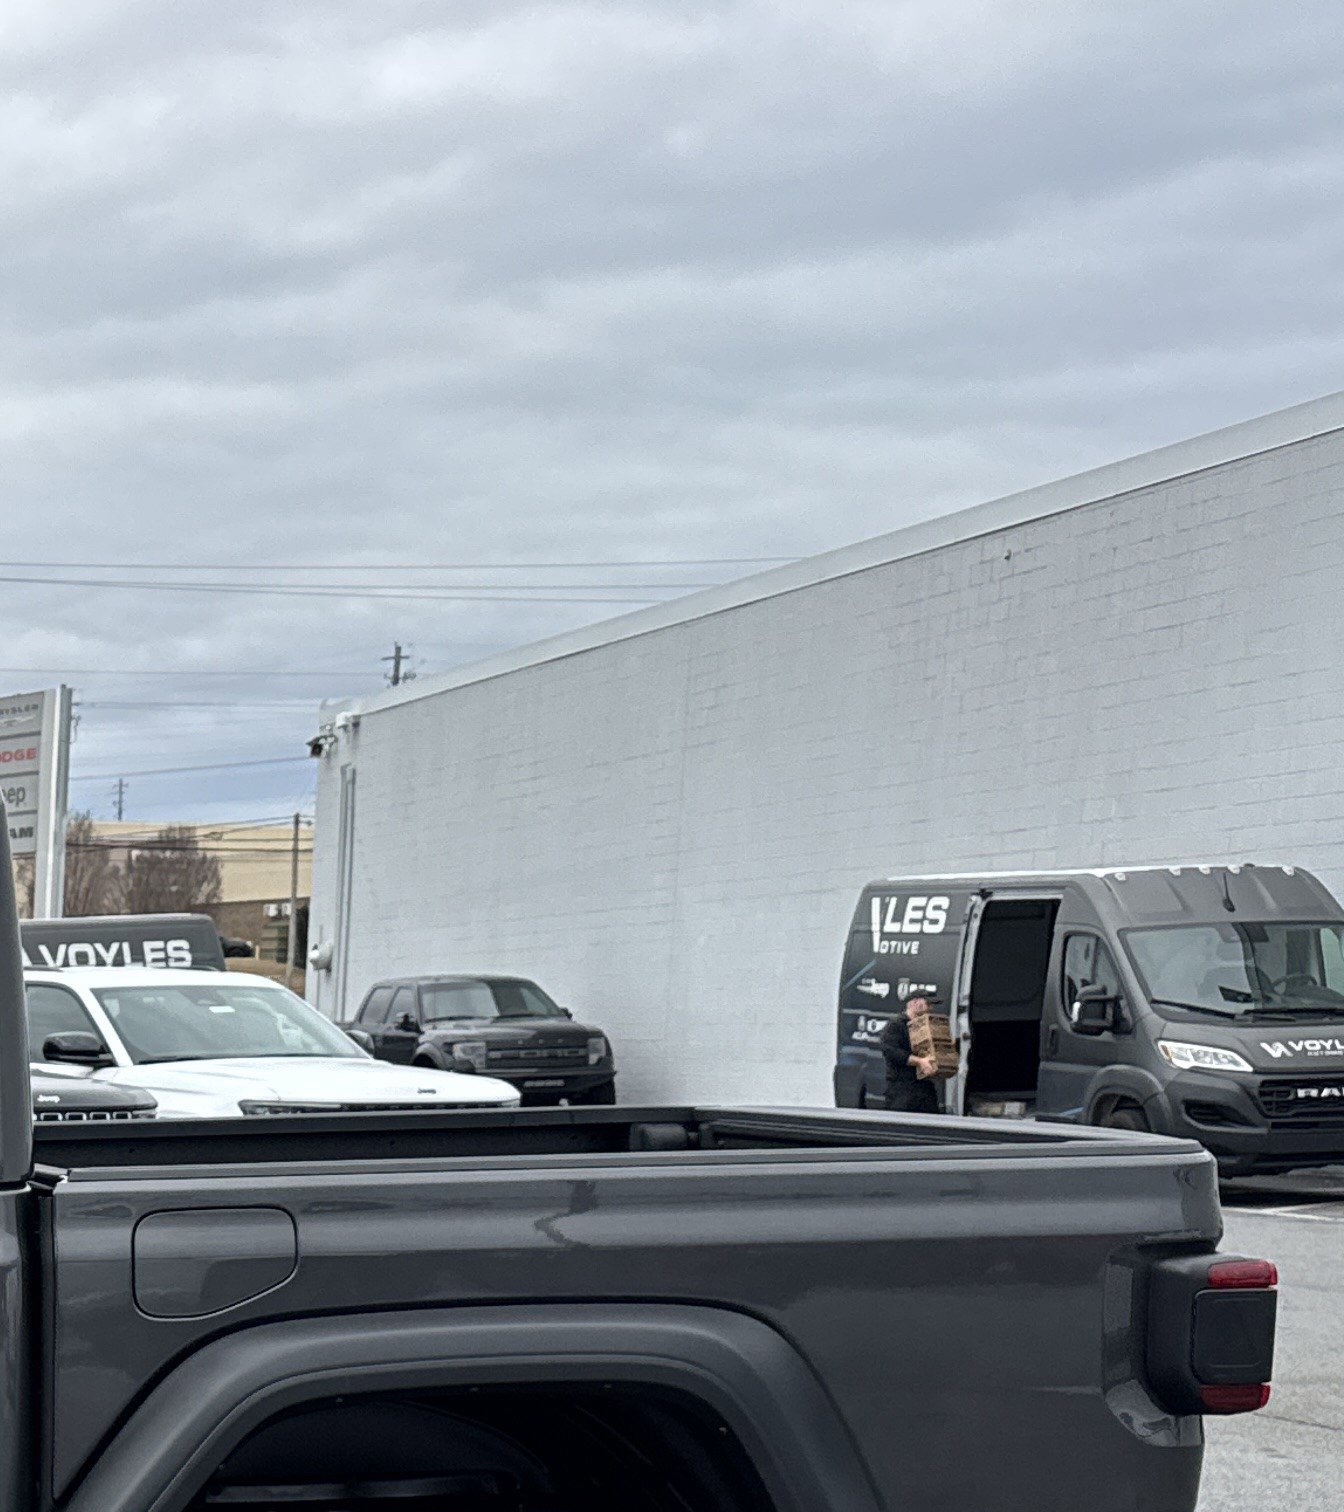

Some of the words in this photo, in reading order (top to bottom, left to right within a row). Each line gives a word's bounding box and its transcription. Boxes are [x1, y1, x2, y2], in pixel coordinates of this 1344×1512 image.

[2, 785, 26, 809] ep
[9, 826, 34, 840] AM
[882, 896, 951, 934] LES
[38, 939, 193, 968] VOYLES
[879, 940, 920, 955] OTIVE
[1288, 1039, 1344, 1052] VOYL
[1296, 1087, 1344, 1099] RA
